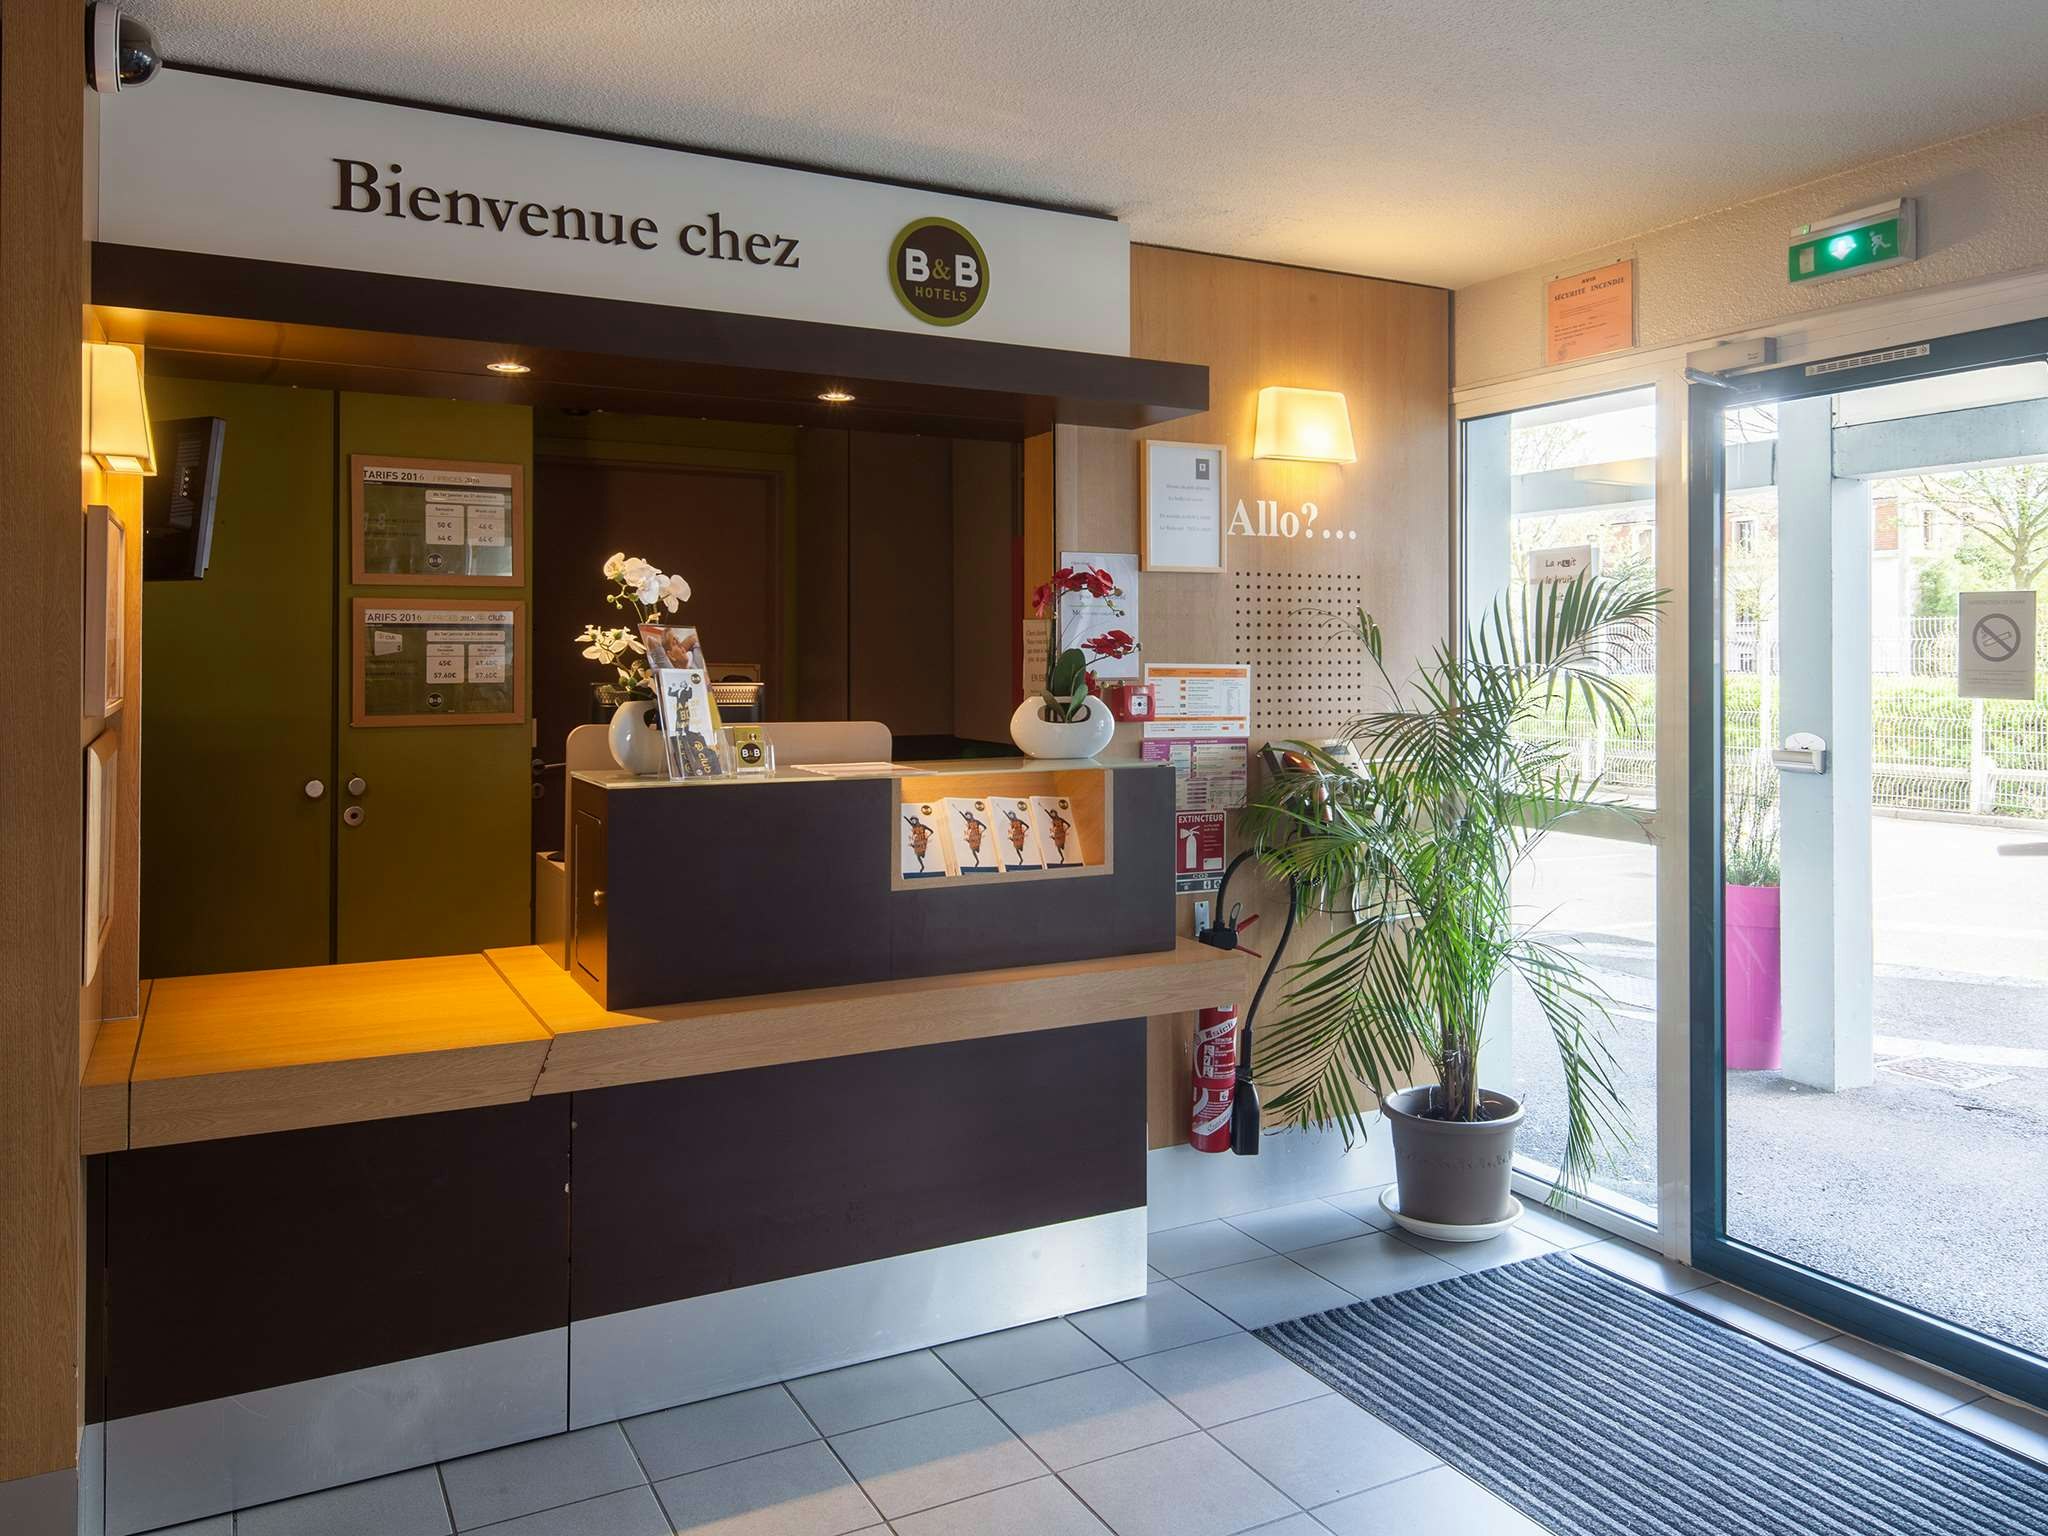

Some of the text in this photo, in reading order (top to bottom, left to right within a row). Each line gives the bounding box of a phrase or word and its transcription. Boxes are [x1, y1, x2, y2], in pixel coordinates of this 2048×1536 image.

[331, 157, 800, 268] Bienvenue chez
[905, 247, 979, 288] B&B
[915, 286, 968, 302] HOTELS
[363, 470, 399, 480] TARIFS
[1178, 814, 1224, 824] EXTINCTEUR
